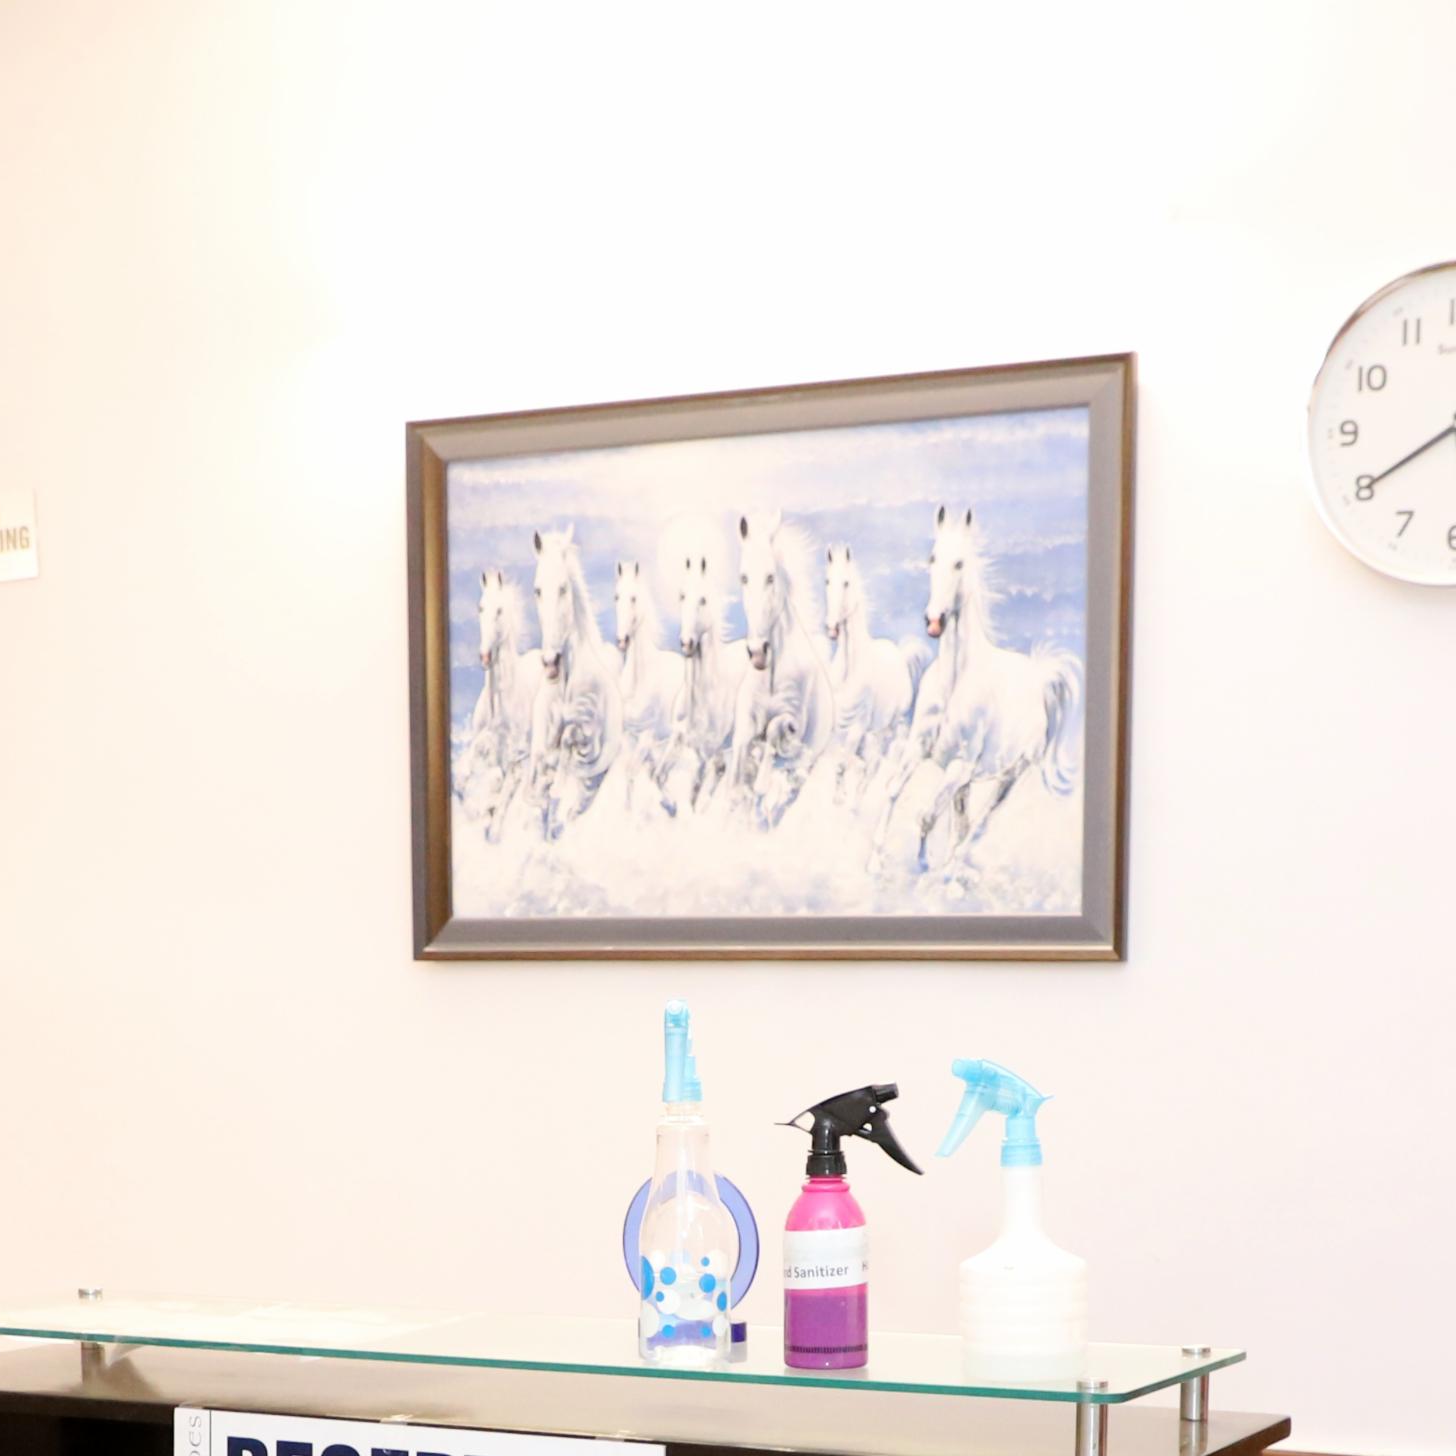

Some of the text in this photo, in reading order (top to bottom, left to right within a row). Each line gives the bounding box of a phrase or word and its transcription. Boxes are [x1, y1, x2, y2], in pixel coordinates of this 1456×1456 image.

[1402, 318, 1421, 345] 11
[1357, 364, 1388, 392] 10
[1340, 420, 1359, 447] 9
[1396, 510, 1414, 537] 7
[794, 1265, 849, 1279] Sanitizer
